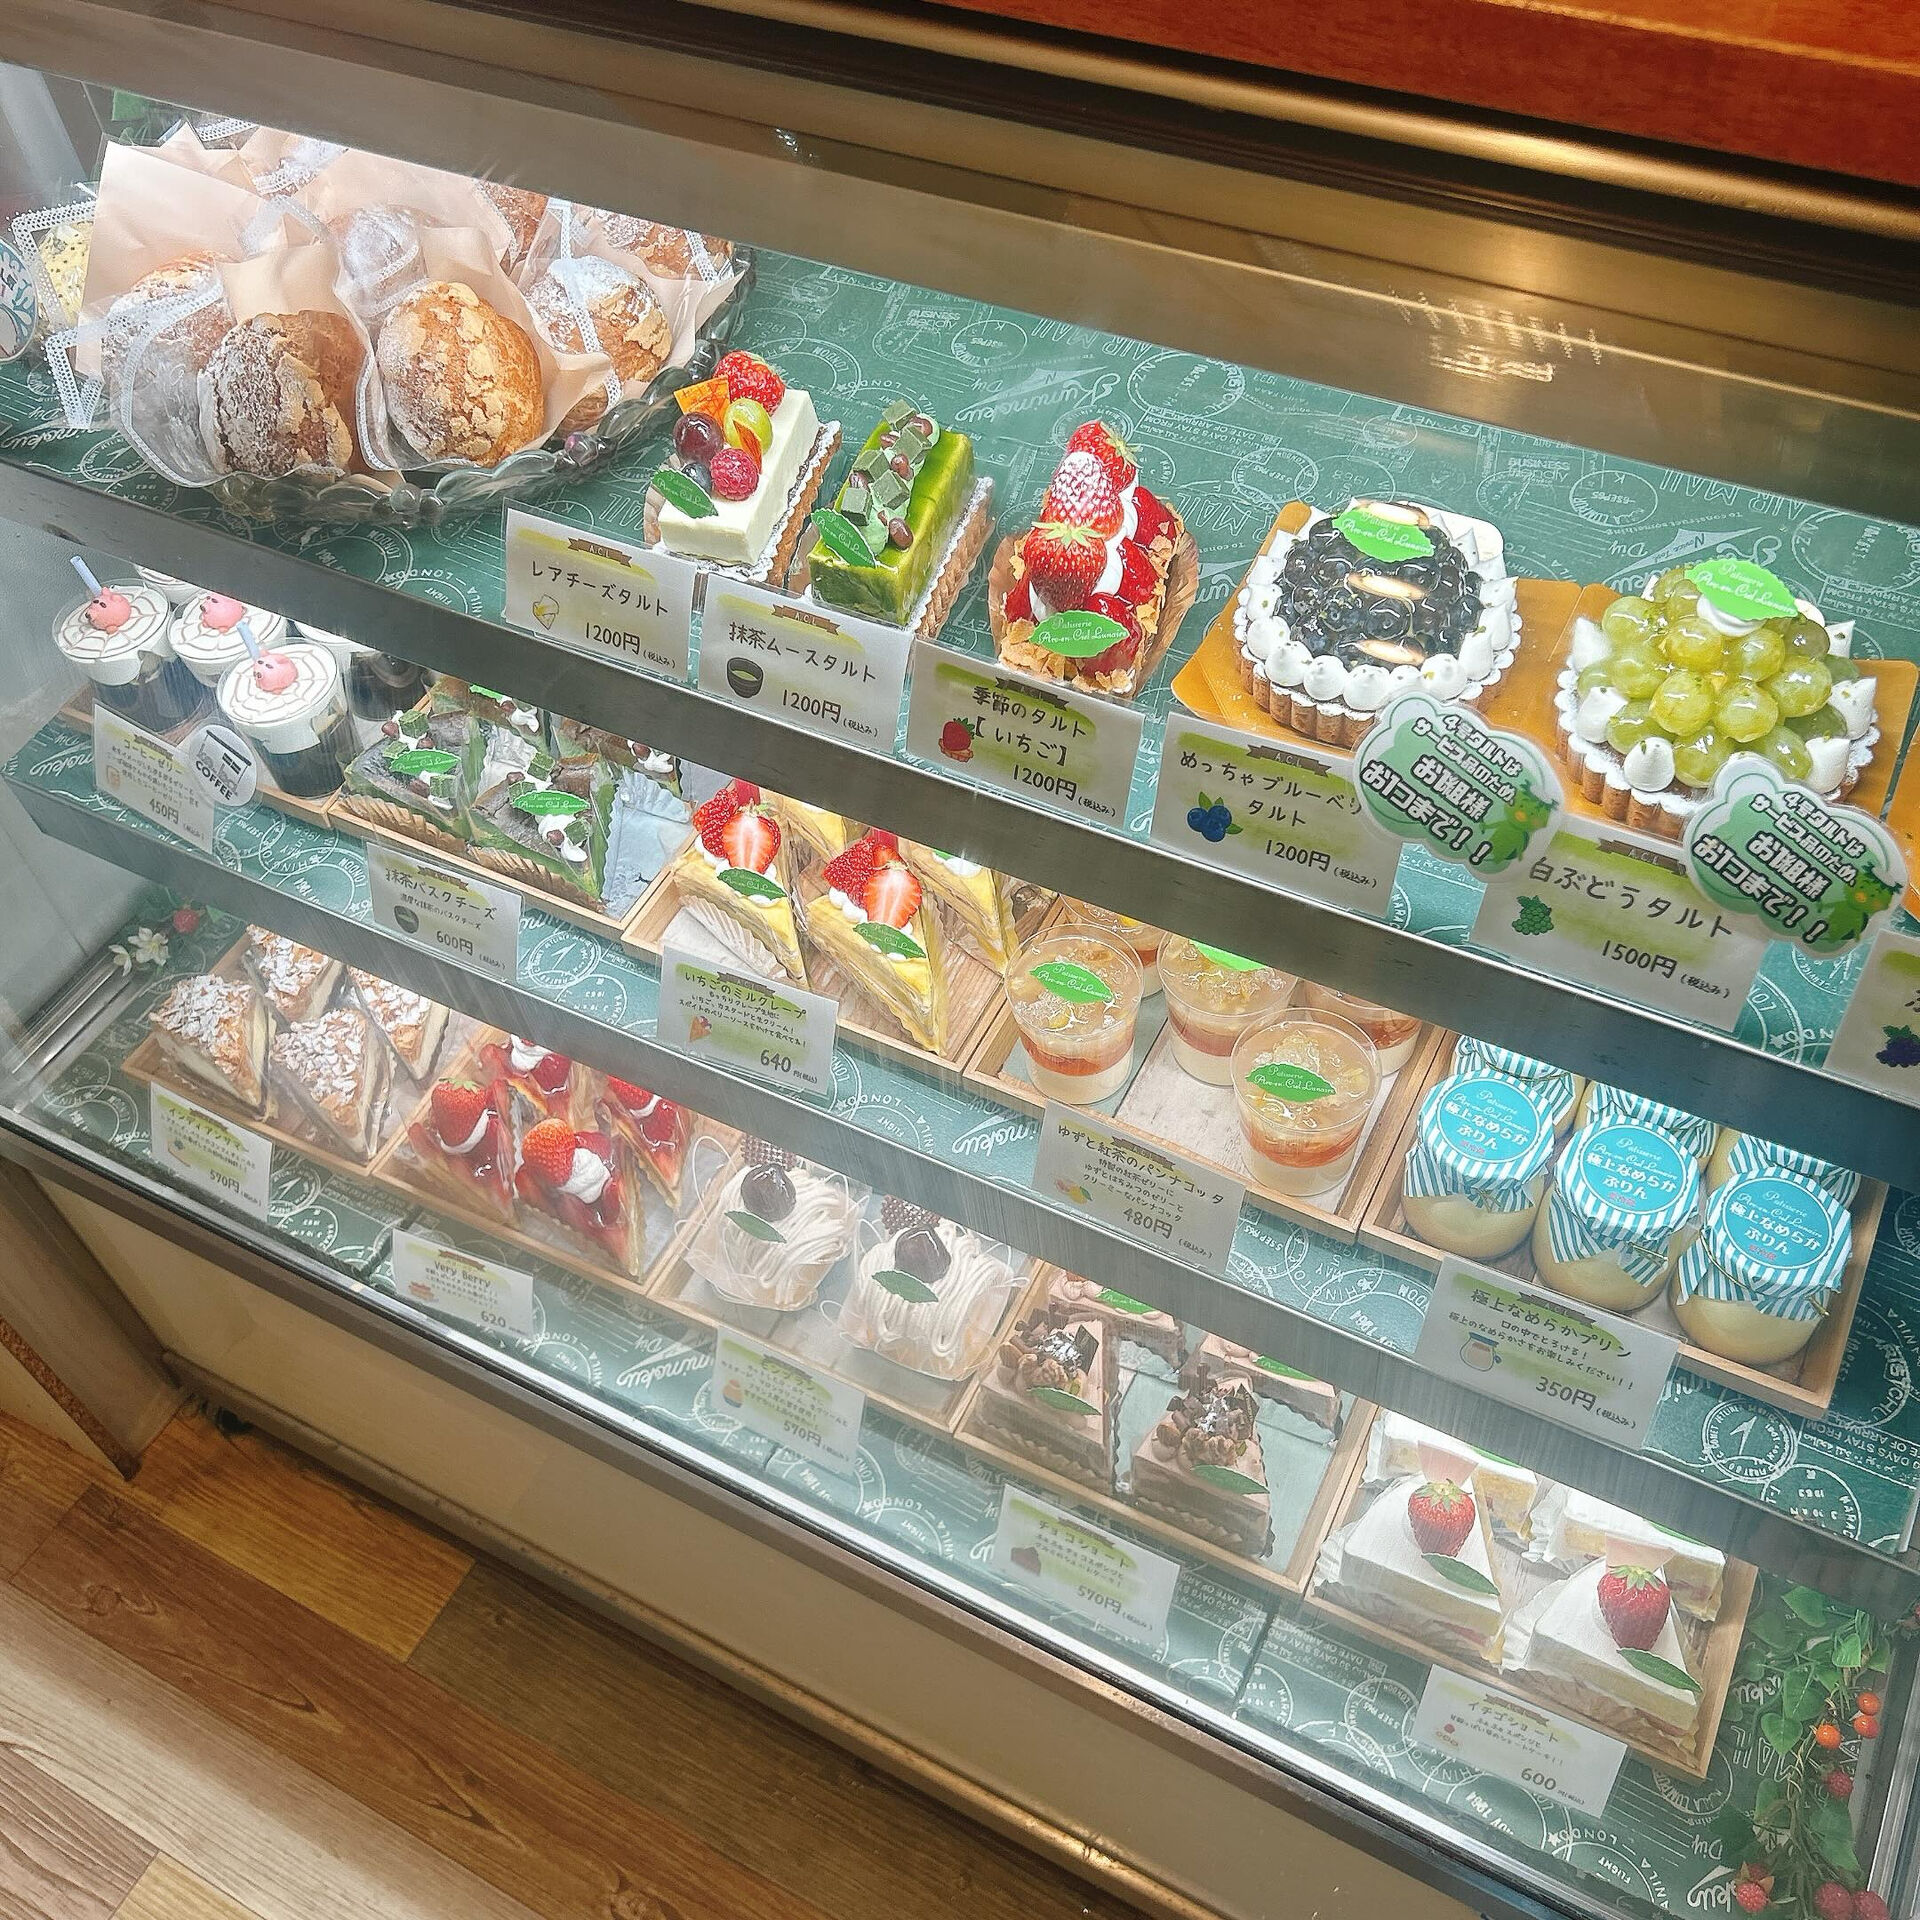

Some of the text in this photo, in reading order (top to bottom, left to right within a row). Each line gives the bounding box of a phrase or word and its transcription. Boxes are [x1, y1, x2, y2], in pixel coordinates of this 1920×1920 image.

[531, 562, 668, 616] レアチーズタルト
[585, 622, 676, 668] 1200円 (税込み)
[729, 622, 876, 682] 抹茶ムースタルト
[782, 690, 878, 737] 1200円 (税込み)
[972, 685, 1086, 737] 季節のタルト
[1443, 714, 1523, 778] 4号タルトは
[195, 760, 233, 801] COFFEE
[1012, 764, 1116, 817] 1200円 (税込み)
[1248, 799, 1306, 827] タルト
[1782, 791, 1866, 859] 4号タルトは
[1265, 839, 1378, 888] 1200円 (税込み)
[385, 867, 497, 921] 抹茶バスクチーズ
[1529, 856, 1733, 940] 白ぶどうタルト
[437, 931, 473, 956] 600円
[1602, 940, 1731, 999] 1500円 (税込み)
[685, 972, 807, 1019] いちごのミルクレープ
[760, 1049, 792, 1073] 640
[1445, 1101, 1528, 1145] 極上なめらか
[1058, 1125, 1224, 1204] ゆずと紅茶のパンナコッタ
[1587, 1152, 1676, 1192] 極上なめらか
[1123, 1208, 1173, 1239] 480円
[1730, 1201, 1820, 1250] 極上なめらか
[434, 1261, 457, 1276] Very
[462, 1270, 491, 1288] Berry
[480, 1311, 506, 1328] 620
[1470, 1288, 1631, 1358] 極上なめらかプリン
[1535, 1376, 1596, 1411] 350円
[783, 1420, 822, 1448] 570円
[1805, 1418, 1842, 1440] FROM
[1844, 1434, 1875, 1453] STAY
[1077, 1585, 1122, 1614] 570円
[1521, 1767, 1557, 1790] 600
